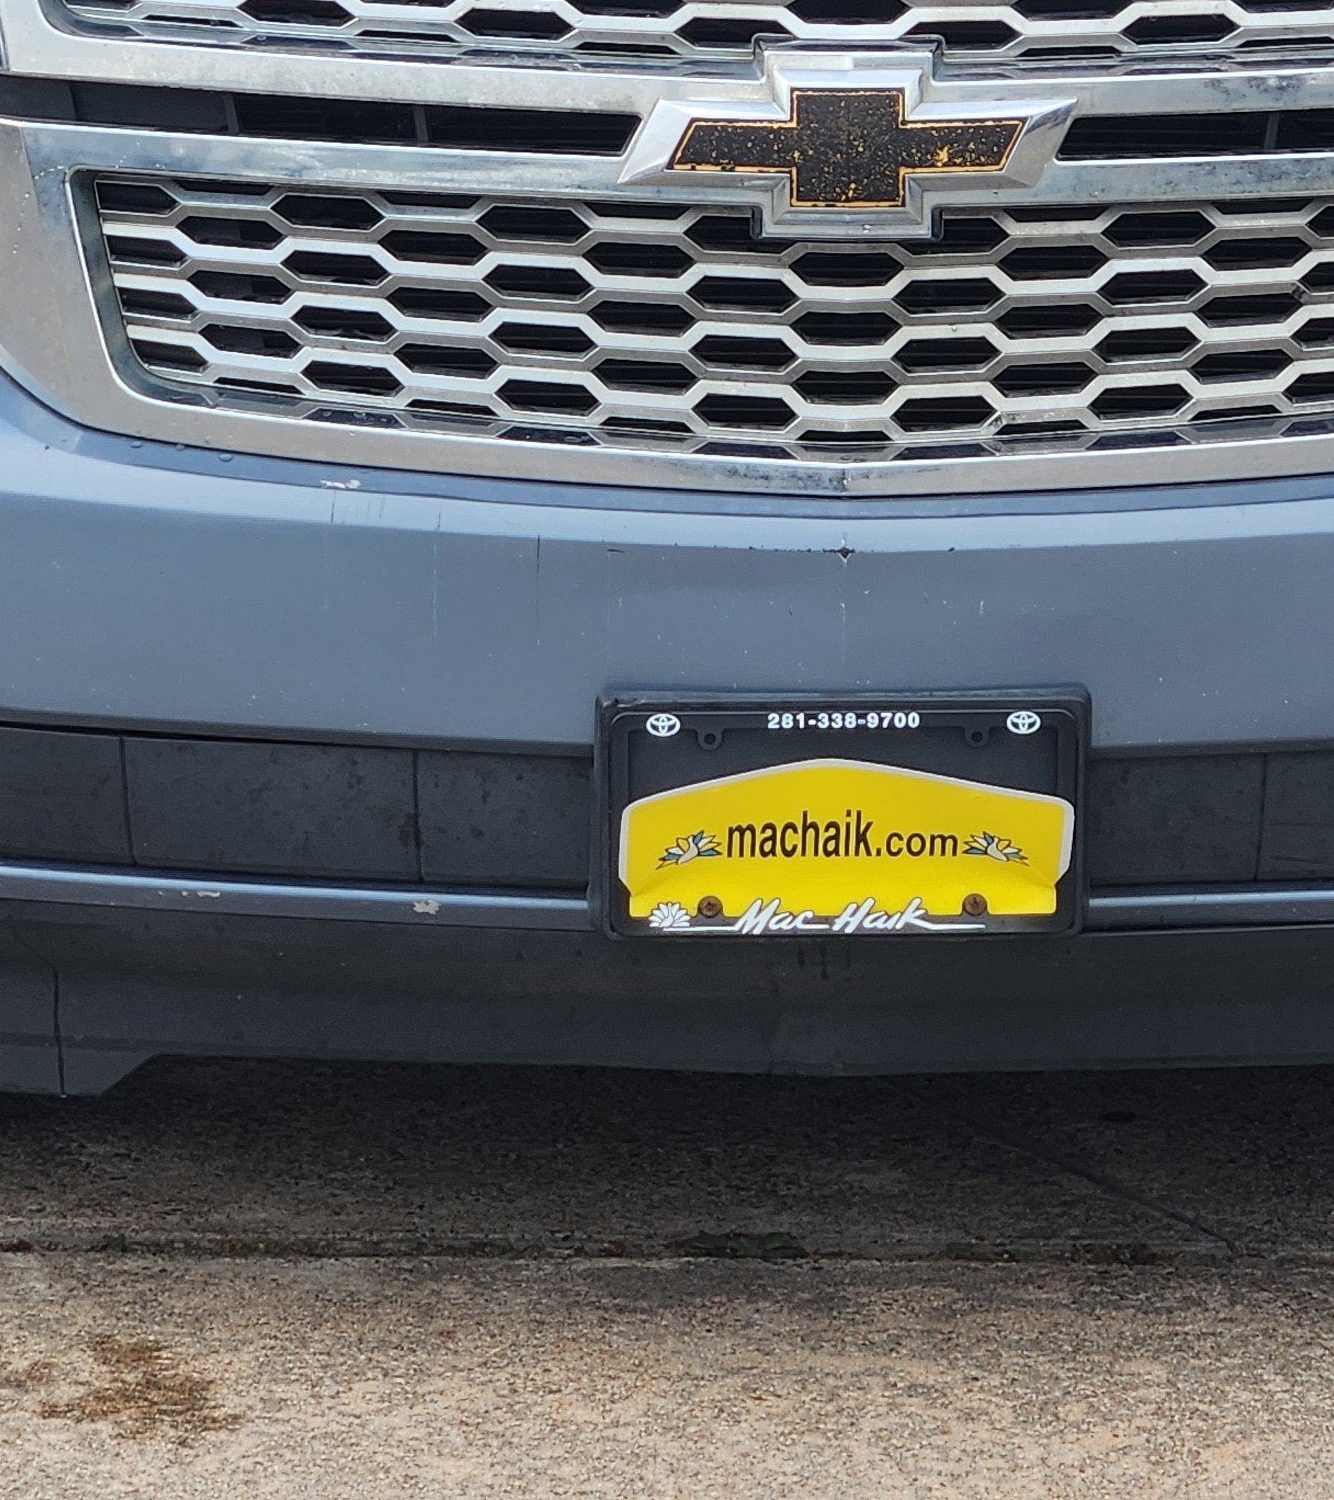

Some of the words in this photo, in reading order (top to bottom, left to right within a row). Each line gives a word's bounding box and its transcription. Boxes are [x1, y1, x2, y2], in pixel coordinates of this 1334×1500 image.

[767, 712, 920, 729] 281-338-9700
[727, 809, 958, 857] machaik.com
[733, 897, 830, 934] Mac
[832, 897, 985, 934] Haik
